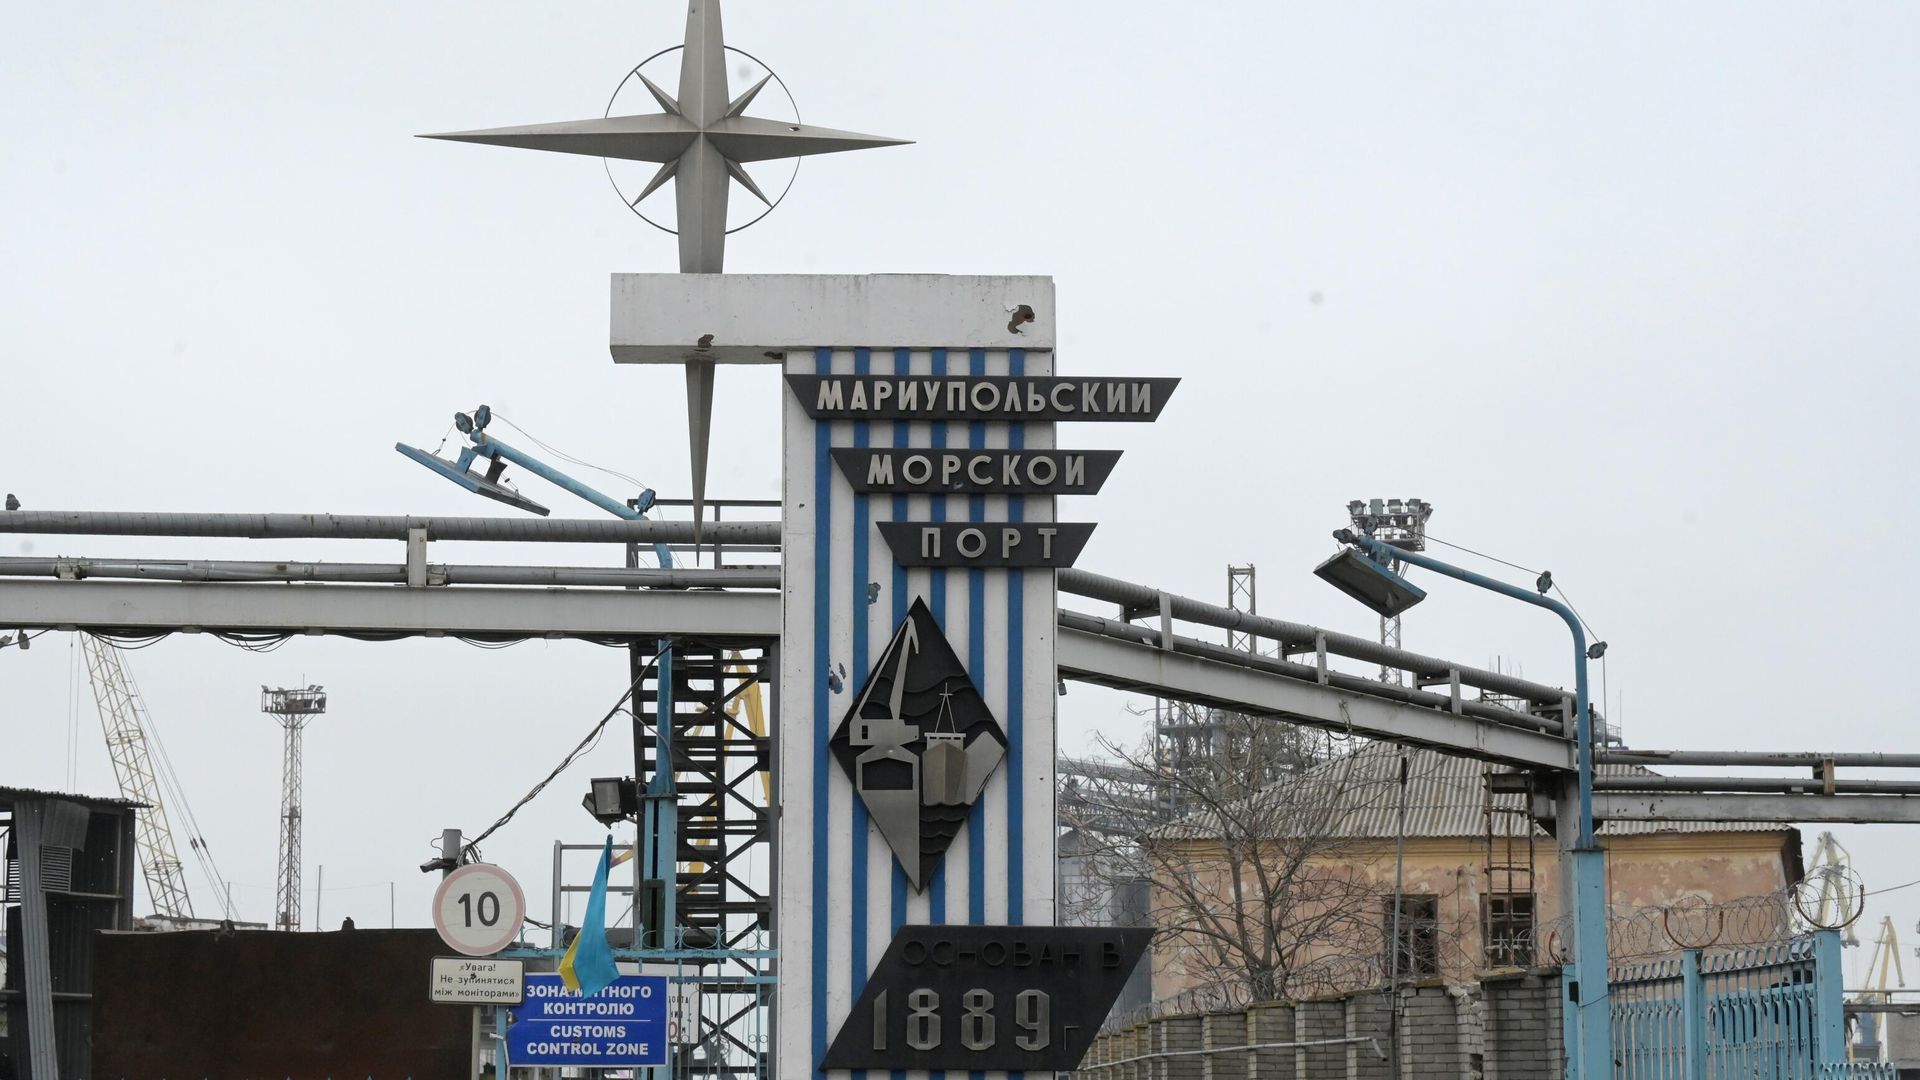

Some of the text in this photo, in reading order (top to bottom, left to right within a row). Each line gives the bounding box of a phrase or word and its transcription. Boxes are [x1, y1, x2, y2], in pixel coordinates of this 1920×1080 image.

[921, 526, 1057, 558] ПОРТ
[457, 891, 500, 928] 10
[902, 940, 1081, 967] ОСНОВАН
[440, 974, 515, 986] Не зупинятися
[434, 987, 453, 996] між
[526, 985, 569, 998] ЗОНА
[543, 1002, 635, 1015] КОНТРОЛЮ
[550, 1025, 626, 1038] CUSTOMS
[526, 1042, 649, 1055] CONTROL ZONE
